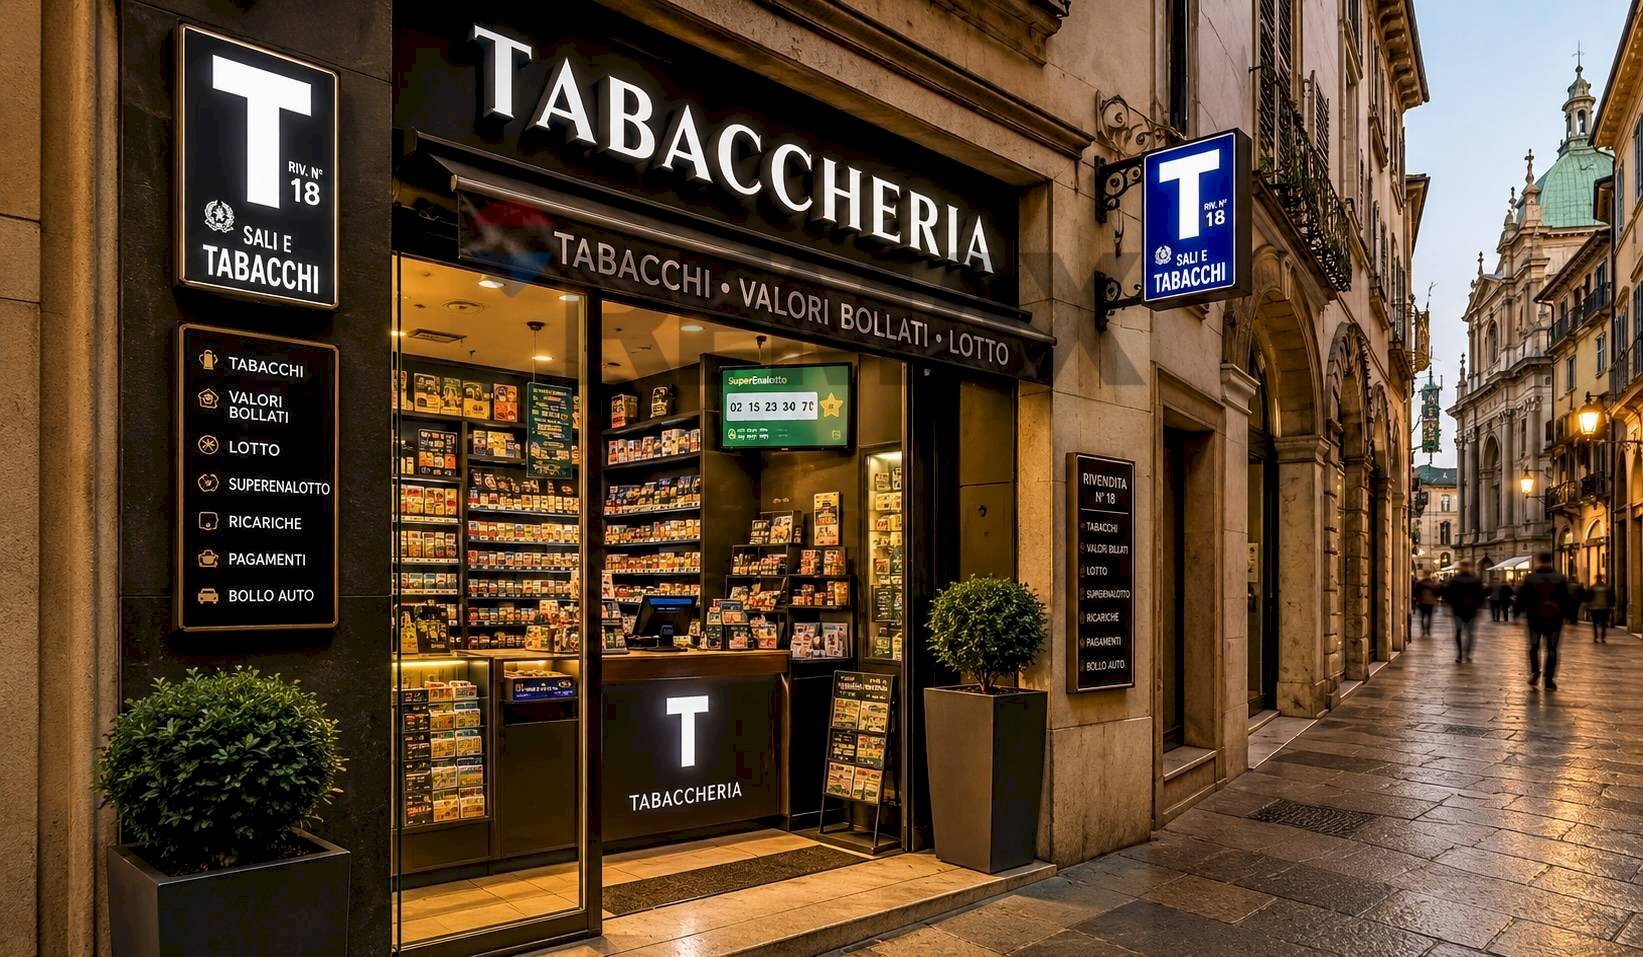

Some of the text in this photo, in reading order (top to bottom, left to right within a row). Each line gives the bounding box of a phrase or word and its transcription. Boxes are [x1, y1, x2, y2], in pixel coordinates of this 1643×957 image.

[212, 54, 312, 209] T
[471, 24, 995, 275] TABACCHERIA
[288, 161, 309, 177] RIV.
[290, 178, 321, 206] 18
[1159, 148, 1220, 240] T
[1204, 201, 1218, 211] RIV.
[1206, 209, 1225, 227] 18
[243, 225, 292, 254] SALI E
[1176, 249, 1207, 267] SALI E
[202, 244, 320, 294] TABACCHI
[1153, 262, 1226, 293] TABACCHI
[553, 230, 1010, 366] TABACCHI VALORI BOLLATI LOTTO
[228, 357, 304, 378] TABACCHI
[728, 376, 787, 387] SuperEnalotto
[228, 390, 283, 408] VALORI
[730, 402, 742, 413] 02
[765, 402, 777, 412] 23
[783, 401, 796, 411] 30
[229, 406, 289, 424] BOLLATI
[229, 441, 280, 457] LOTTO
[228, 477, 331, 496] SUPERENALOTTO
[1083, 473, 1128, 490] RIVENDITA
[1106, 492, 1116, 505] 18
[229, 515, 302, 530] RICARICHE
[1086, 521, 1118, 533] TABACCHI
[228, 552, 306, 566] PAGAMENTI
[1086, 566, 1108, 576] LOTTO
[228, 589, 315, 603] BOLLO AUTO
[1086, 612, 1119, 622] RICARICHE
[1086, 637, 1121, 648] PAGAMENTI
[1086, 660, 1126, 671] BOLLO AUTO
[666, 695, 709, 768] T
[629, 781, 742, 811] TABACCHERIA
